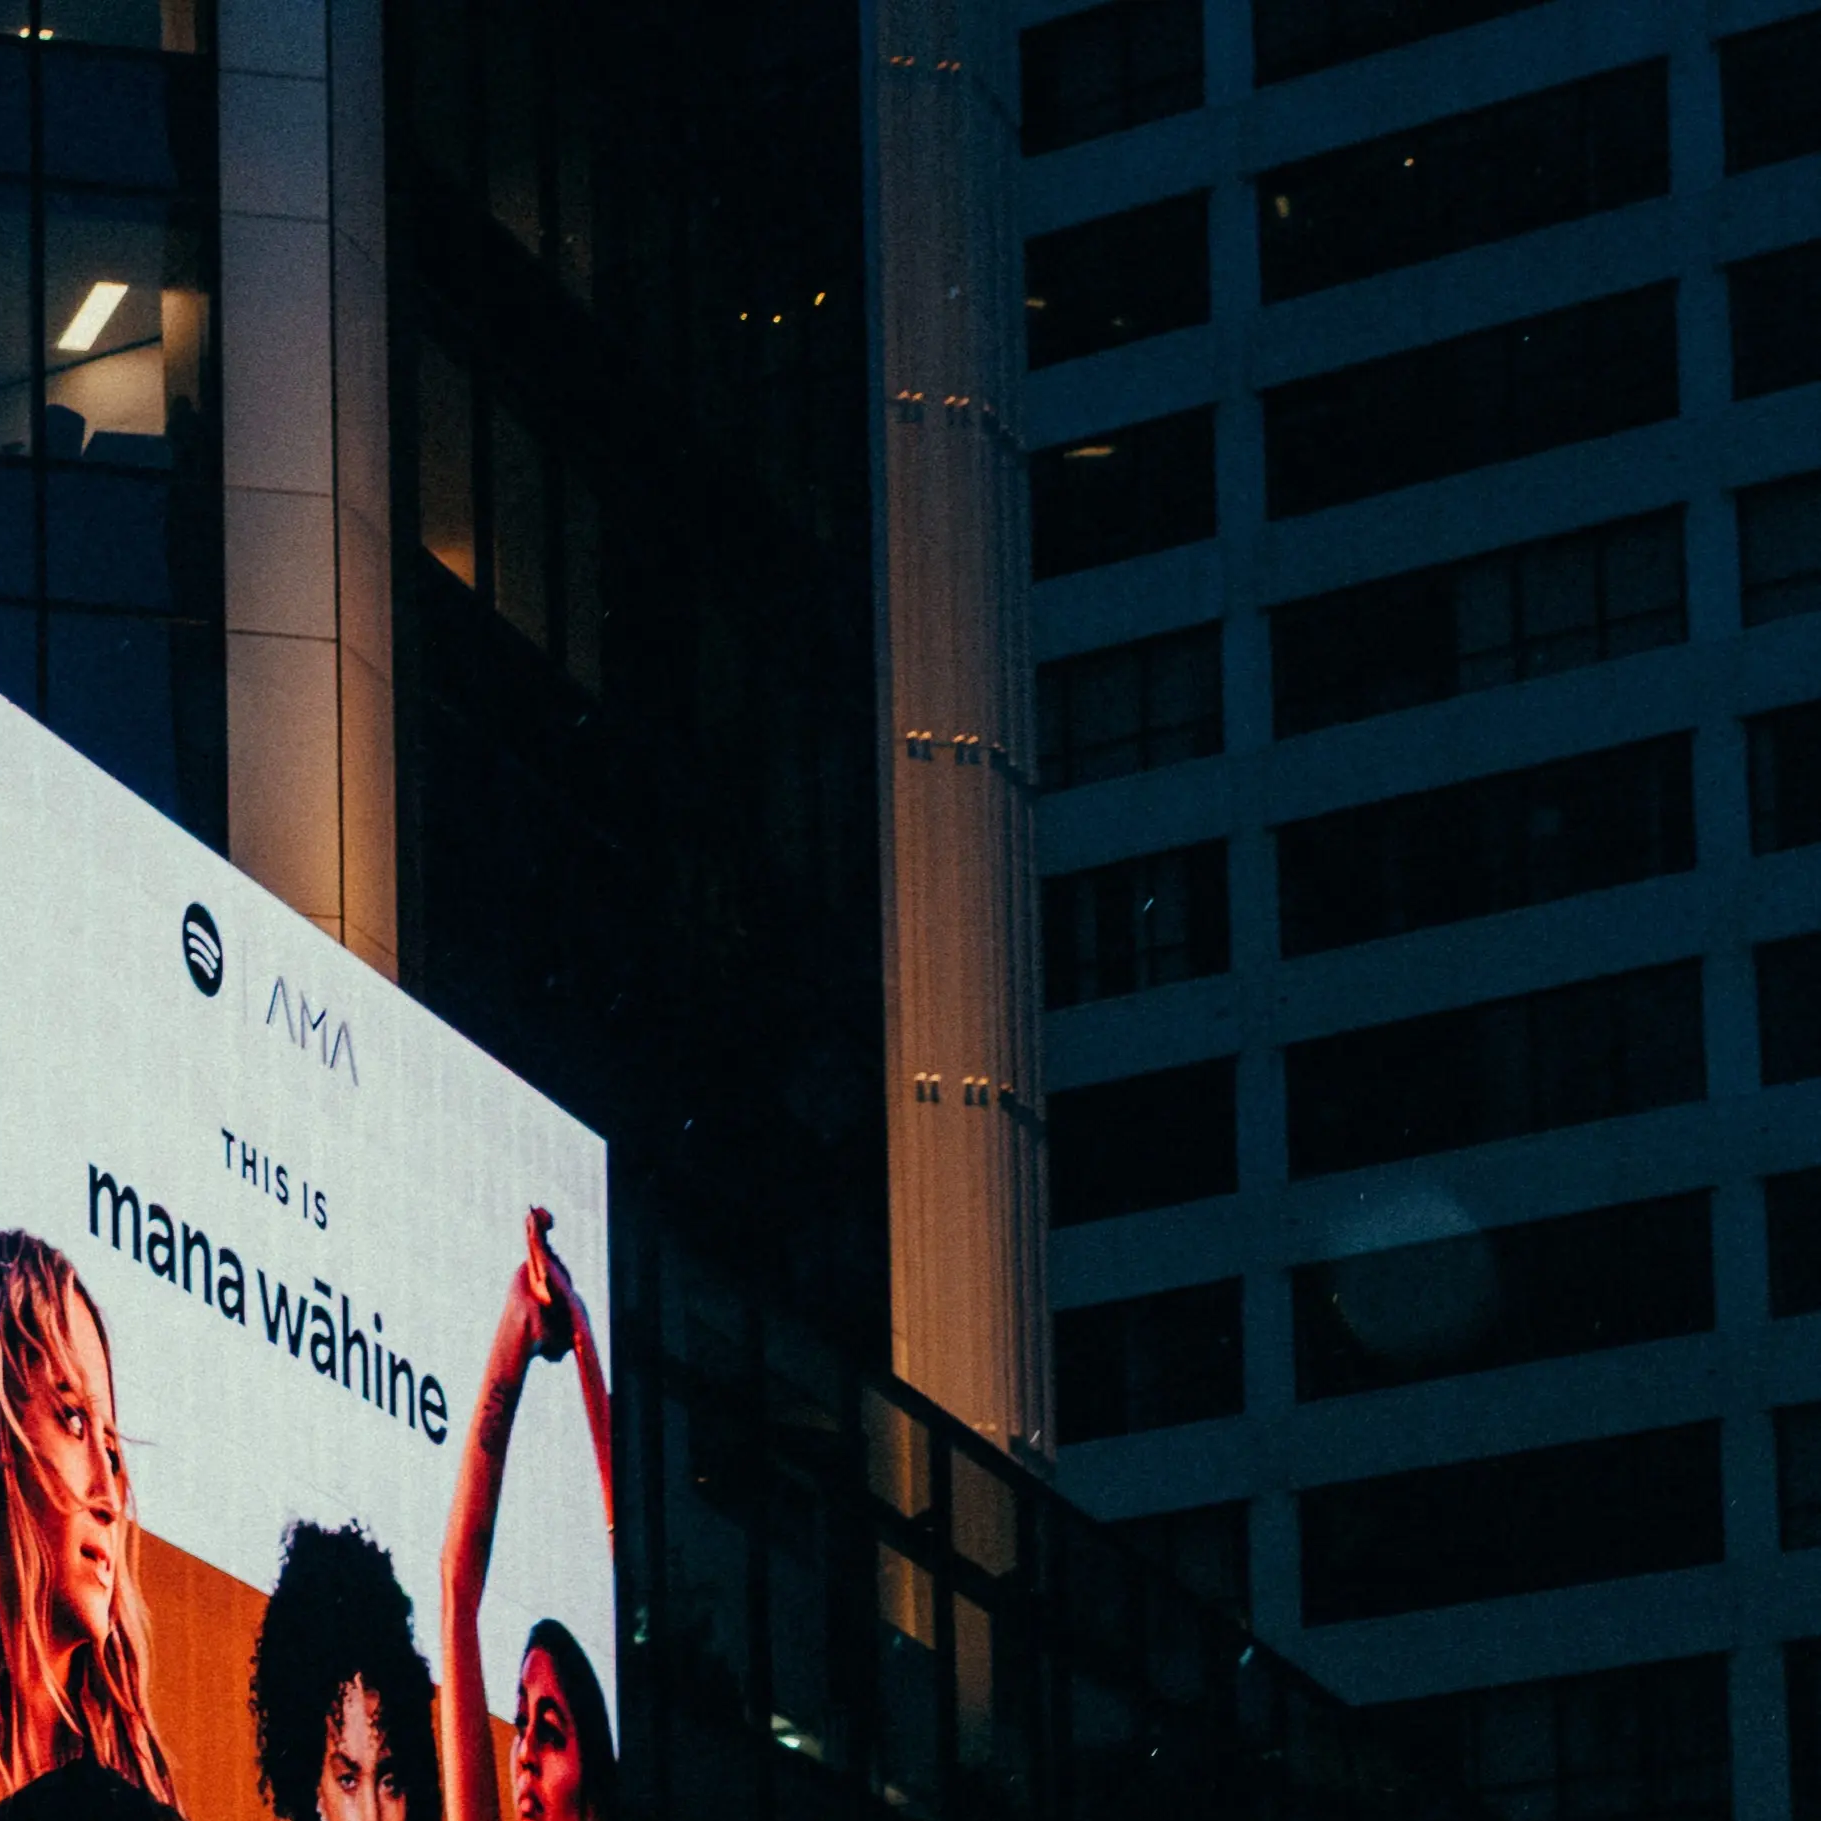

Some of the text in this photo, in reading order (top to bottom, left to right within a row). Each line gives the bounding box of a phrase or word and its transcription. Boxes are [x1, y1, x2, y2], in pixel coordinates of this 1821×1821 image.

[266, 975, 360, 1088] AMA
[221, 1127, 329, 1231] THIS IS
[87, 1161, 449, 1446] mana wāhine
